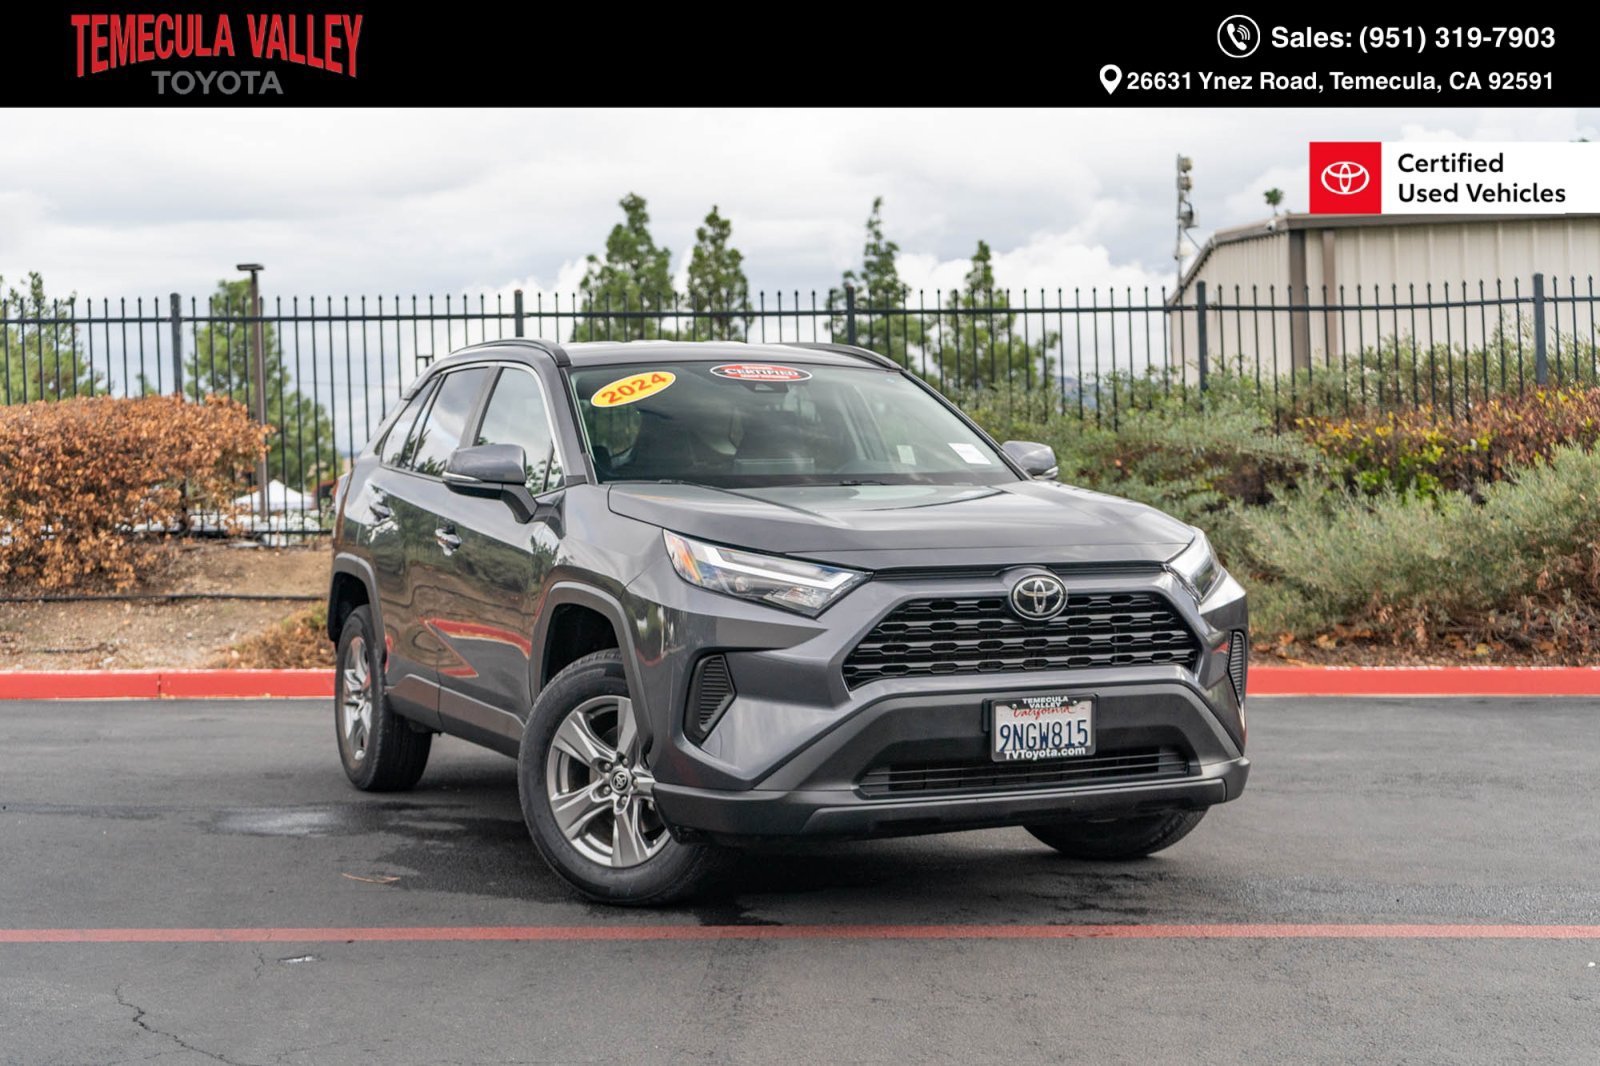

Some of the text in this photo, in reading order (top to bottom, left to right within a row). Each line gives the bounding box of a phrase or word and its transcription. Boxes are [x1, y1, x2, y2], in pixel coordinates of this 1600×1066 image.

[601, 373, 667, 404] 2024
[1022, 695, 1069, 705] TEMECULA
[1029, 701, 1062, 709] VALLEY
[999, 719, 1088, 753] 9NGW815
[1003, 746, 1086, 761] TVToyota.com
